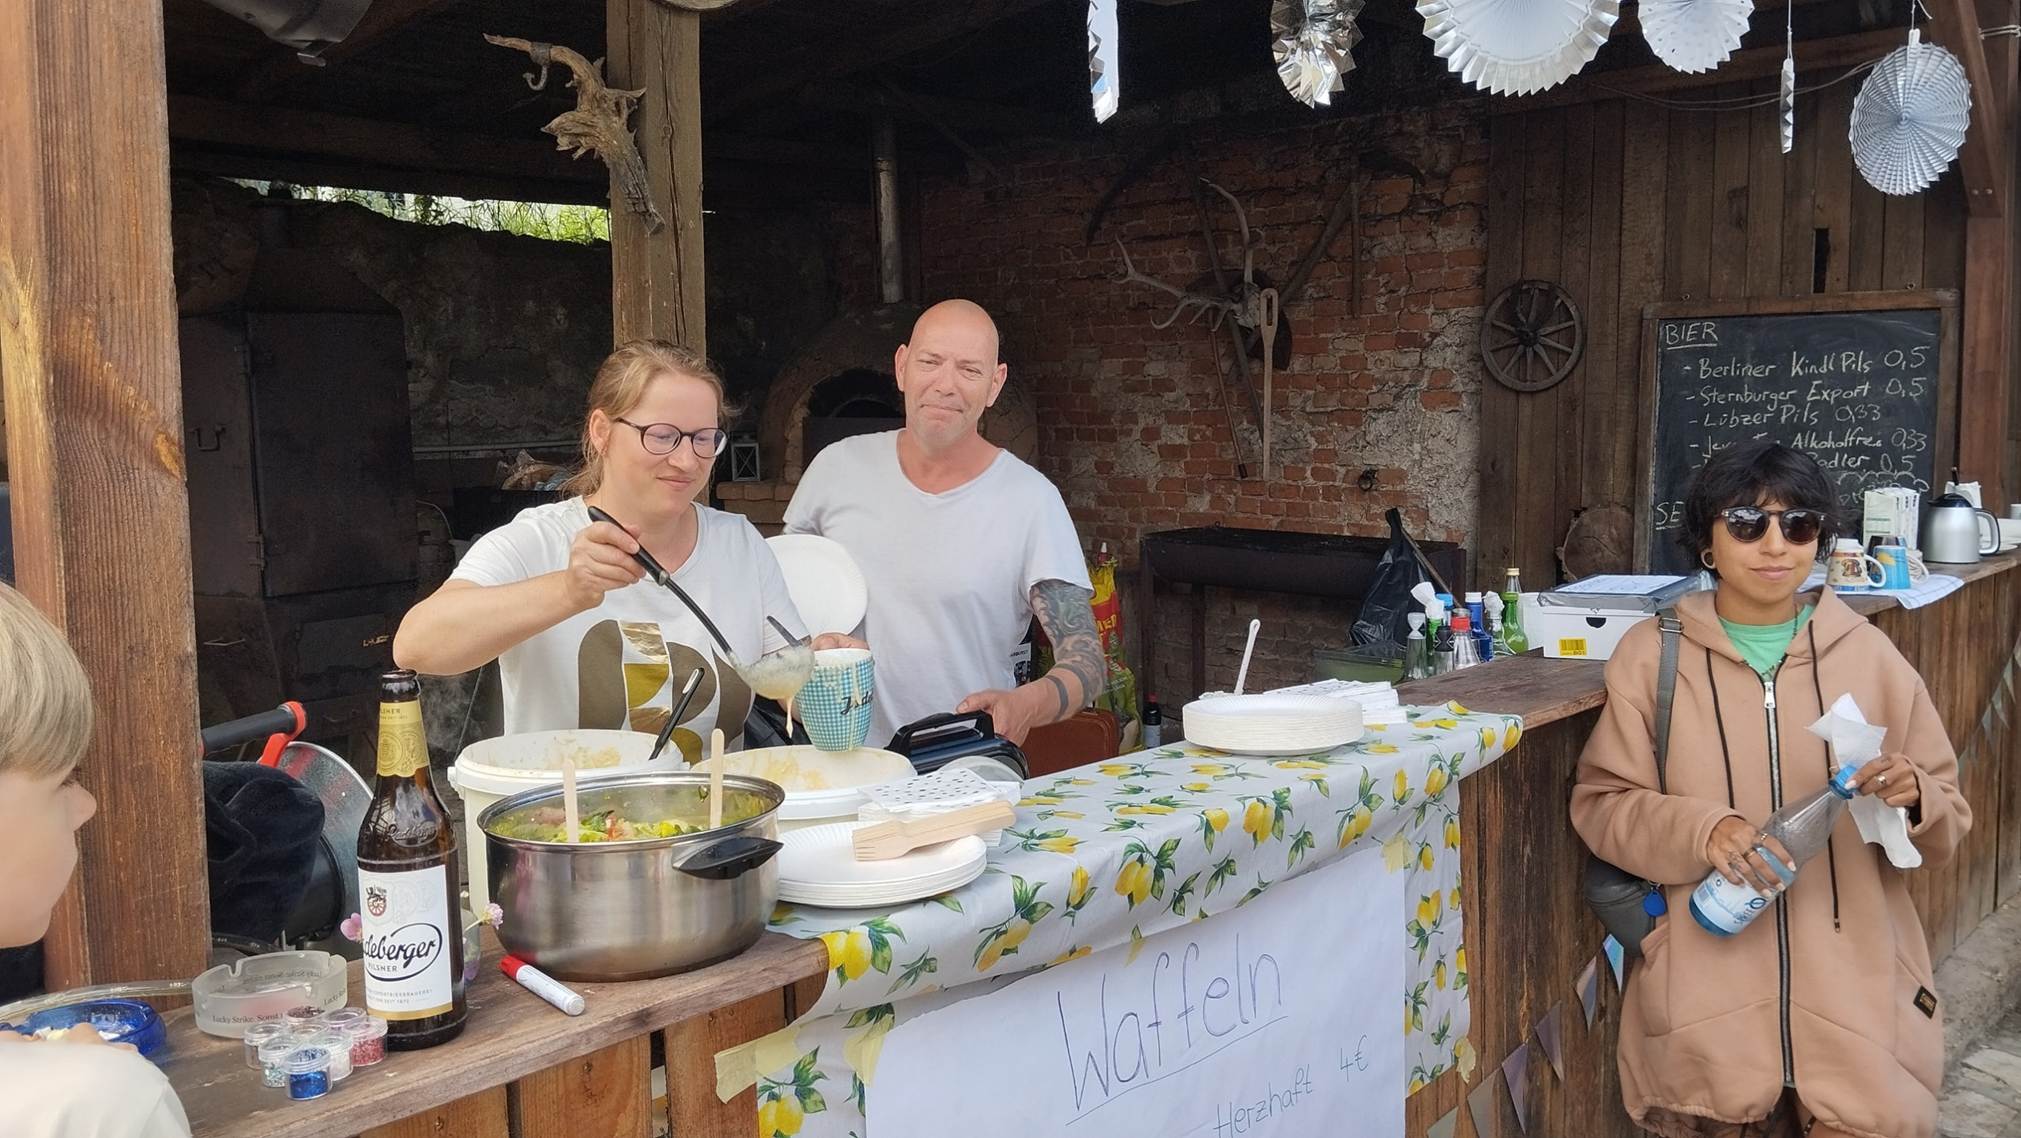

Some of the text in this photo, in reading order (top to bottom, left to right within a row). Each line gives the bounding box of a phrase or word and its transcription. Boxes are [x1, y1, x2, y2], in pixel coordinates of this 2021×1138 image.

[1665, 321, 1719, 345] BIER
[1699, 346, 1930, 379] Berliner Kindl Pils 0,5
[1699, 376, 1928, 412] Sternburger Export 0,5
[1703, 402, 1881, 426] Lübzer Pils 0,33
[1891, 426, 1928, 451] 0,33
[1880, 452, 1917, 474] 0,5
[1655, 501, 1685, 526] SE
[212, 1015, 231, 1024] Lucky
[1058, 933, 1282, 1111] Waffeln
[1213, 1034, 1370, 1138] Herzhaft 4€
